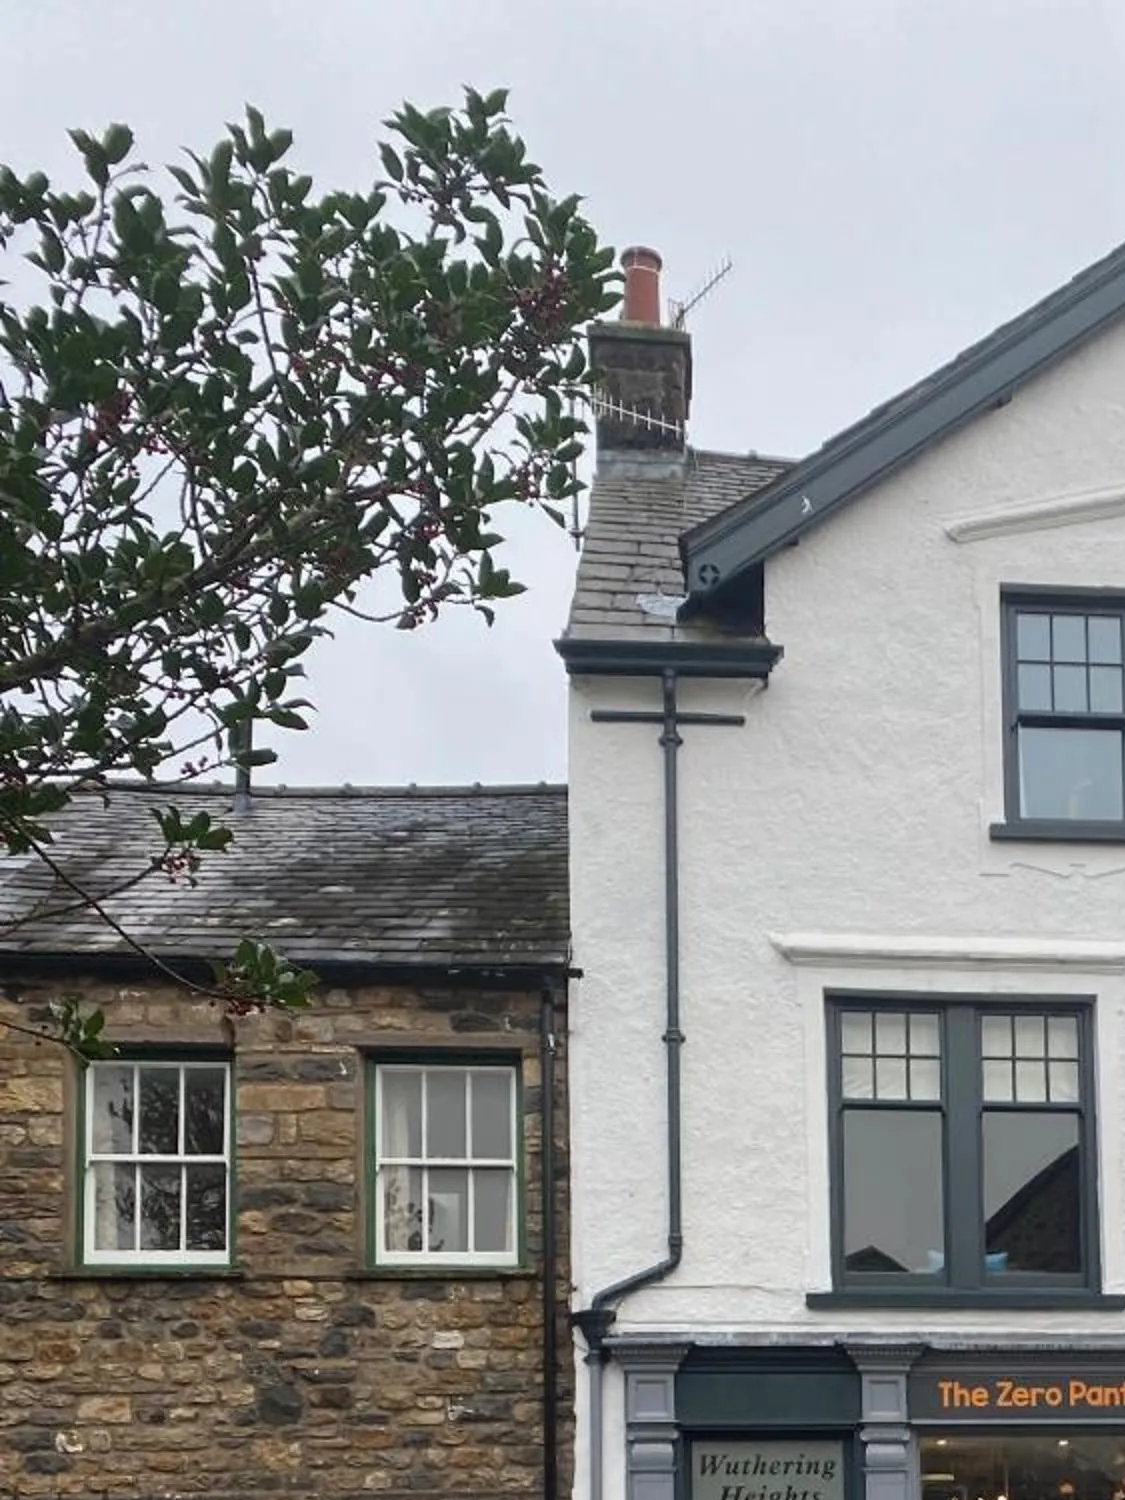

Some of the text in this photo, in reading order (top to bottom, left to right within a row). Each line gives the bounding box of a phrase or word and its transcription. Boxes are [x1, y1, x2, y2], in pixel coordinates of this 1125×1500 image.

[938, 1381, 989, 1407] The
[996, 1381, 1062, 1407] Zero
[700, 1453, 837, 1481] Wuthering
